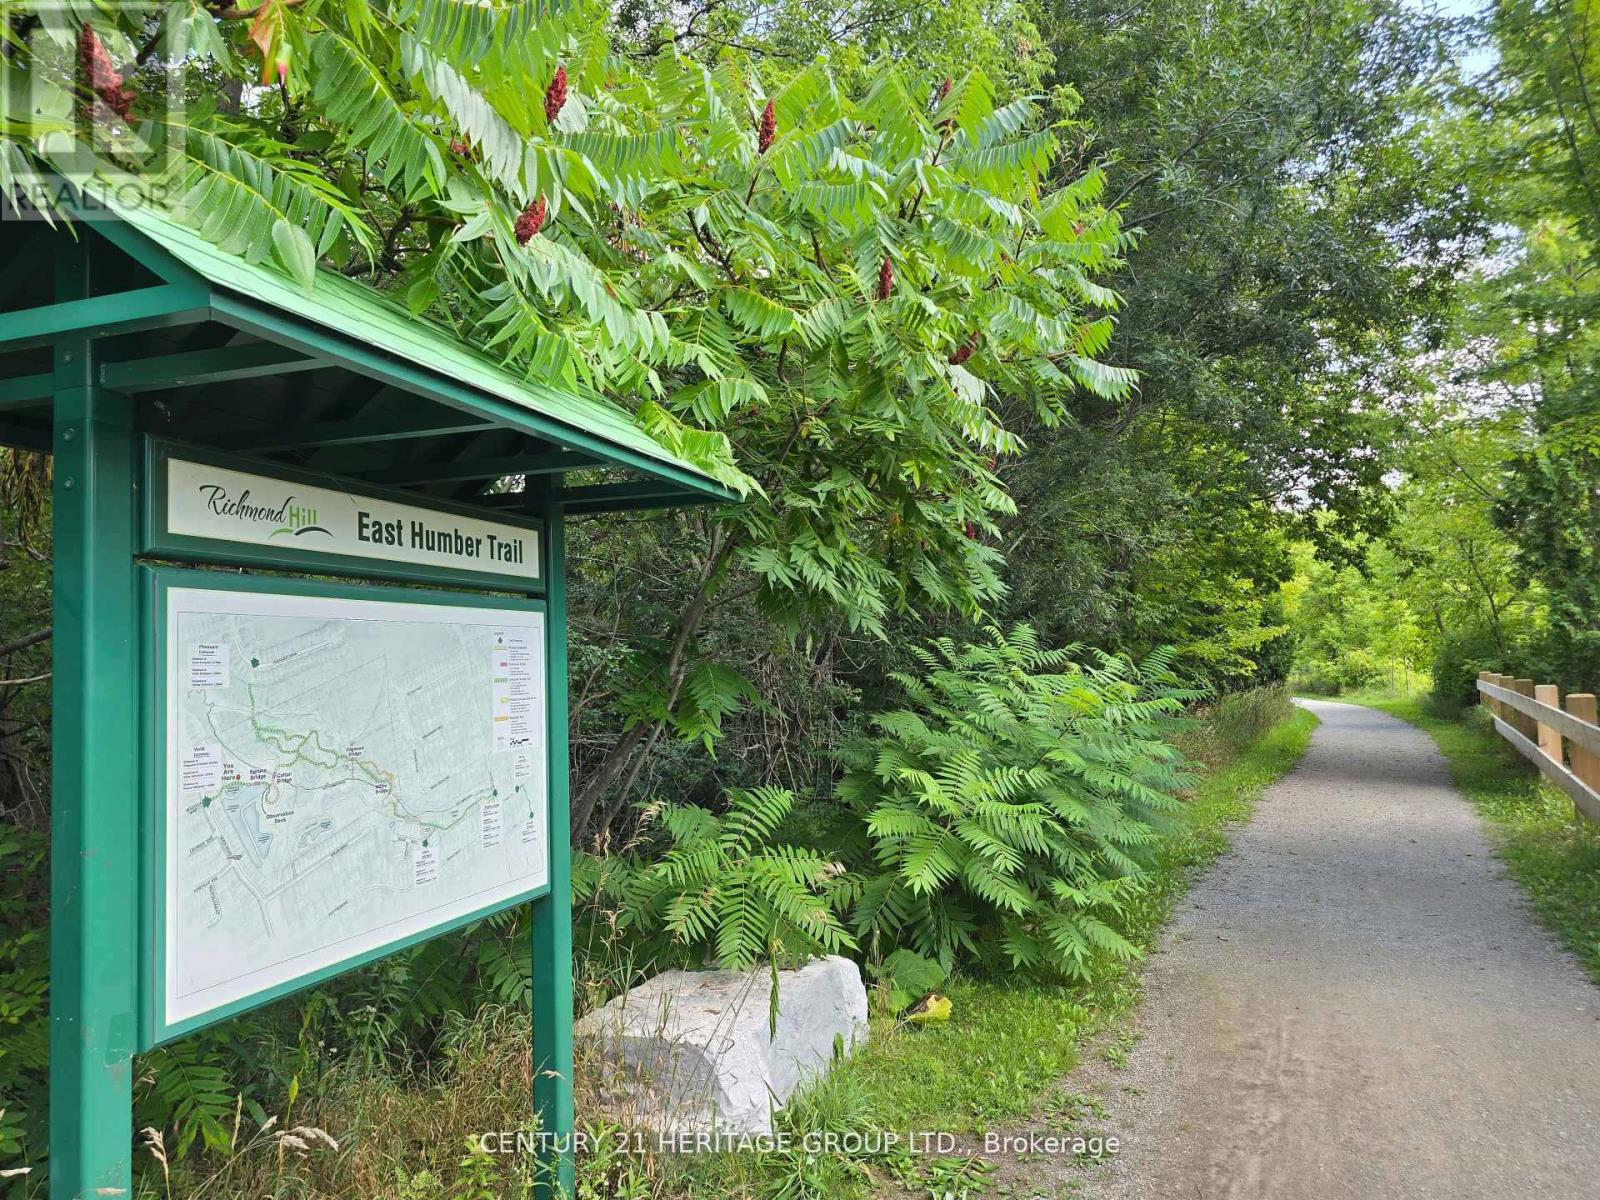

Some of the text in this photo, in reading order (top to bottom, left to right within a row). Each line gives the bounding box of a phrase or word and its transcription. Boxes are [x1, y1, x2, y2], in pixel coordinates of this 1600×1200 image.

[199, 485, 317, 528] Richmond Hill
[358, 511, 523, 564] East Humber Trail
